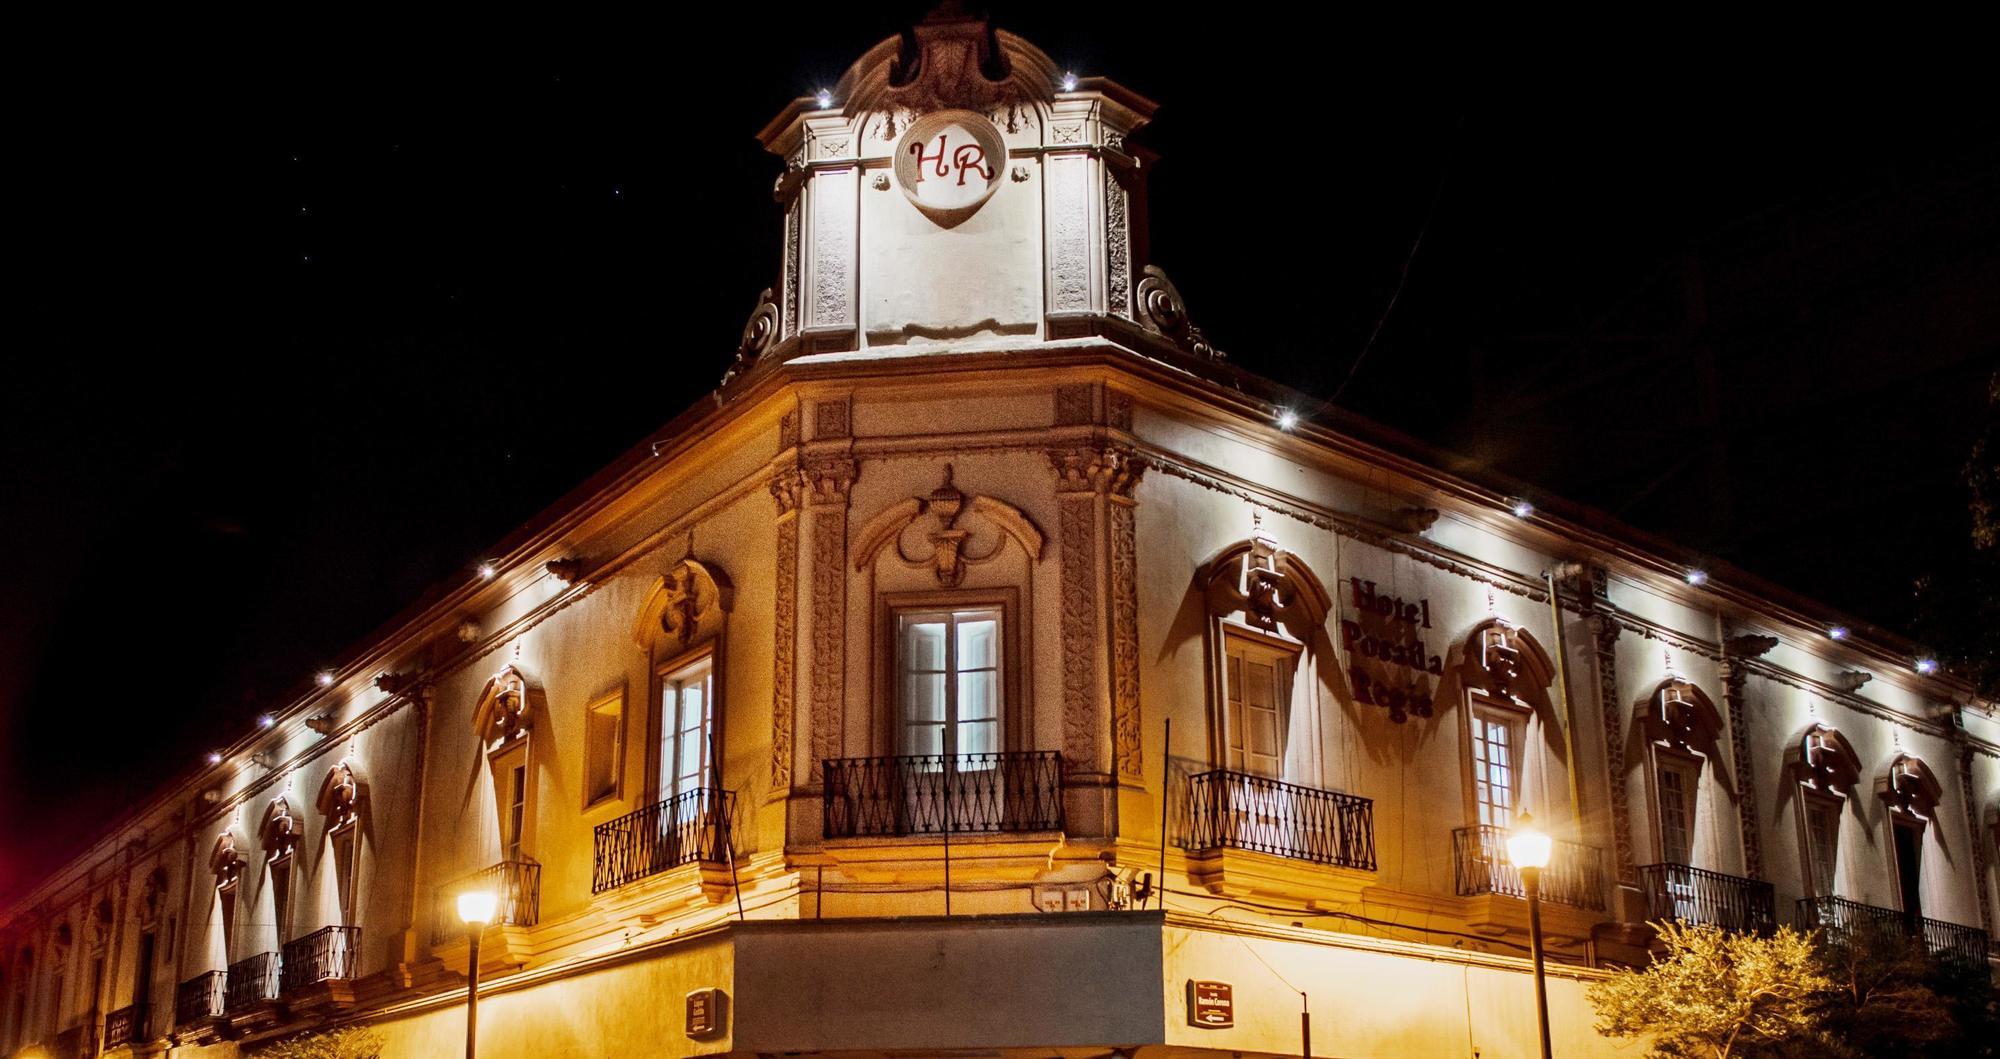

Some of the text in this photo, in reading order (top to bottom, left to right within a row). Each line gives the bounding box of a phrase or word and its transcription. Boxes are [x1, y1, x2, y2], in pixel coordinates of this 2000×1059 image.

[910, 135, 994, 186] HR
[1351, 576, 1432, 629] Hotel
[1341, 619, 1444, 676] Posada
[1349, 666, 1433, 724] Regis
